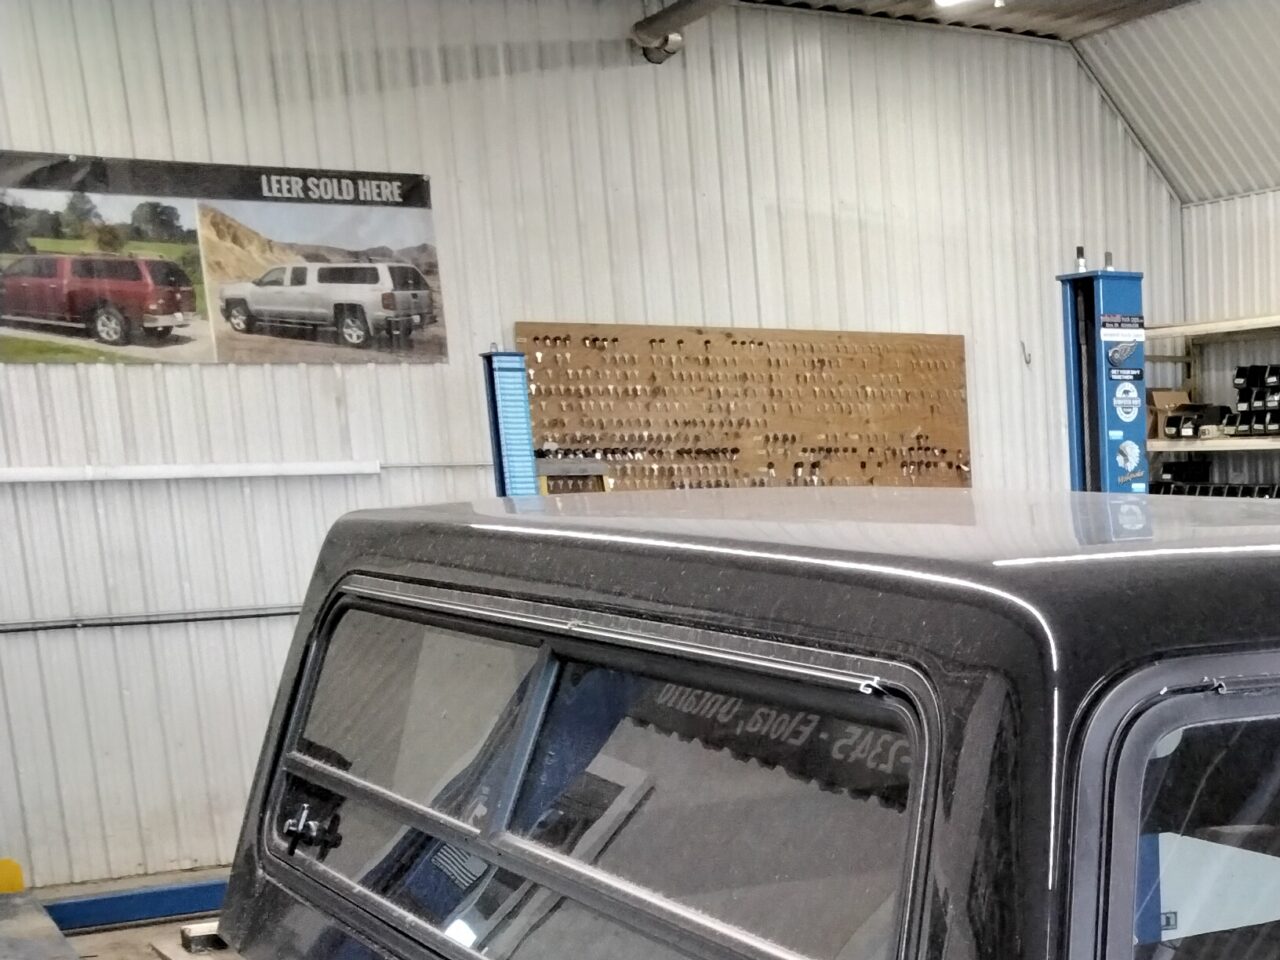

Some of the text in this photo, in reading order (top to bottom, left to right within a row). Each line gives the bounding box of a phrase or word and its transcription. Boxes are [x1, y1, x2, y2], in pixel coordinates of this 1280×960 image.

[261, 174, 403, 202] LEER SOLD HERE
